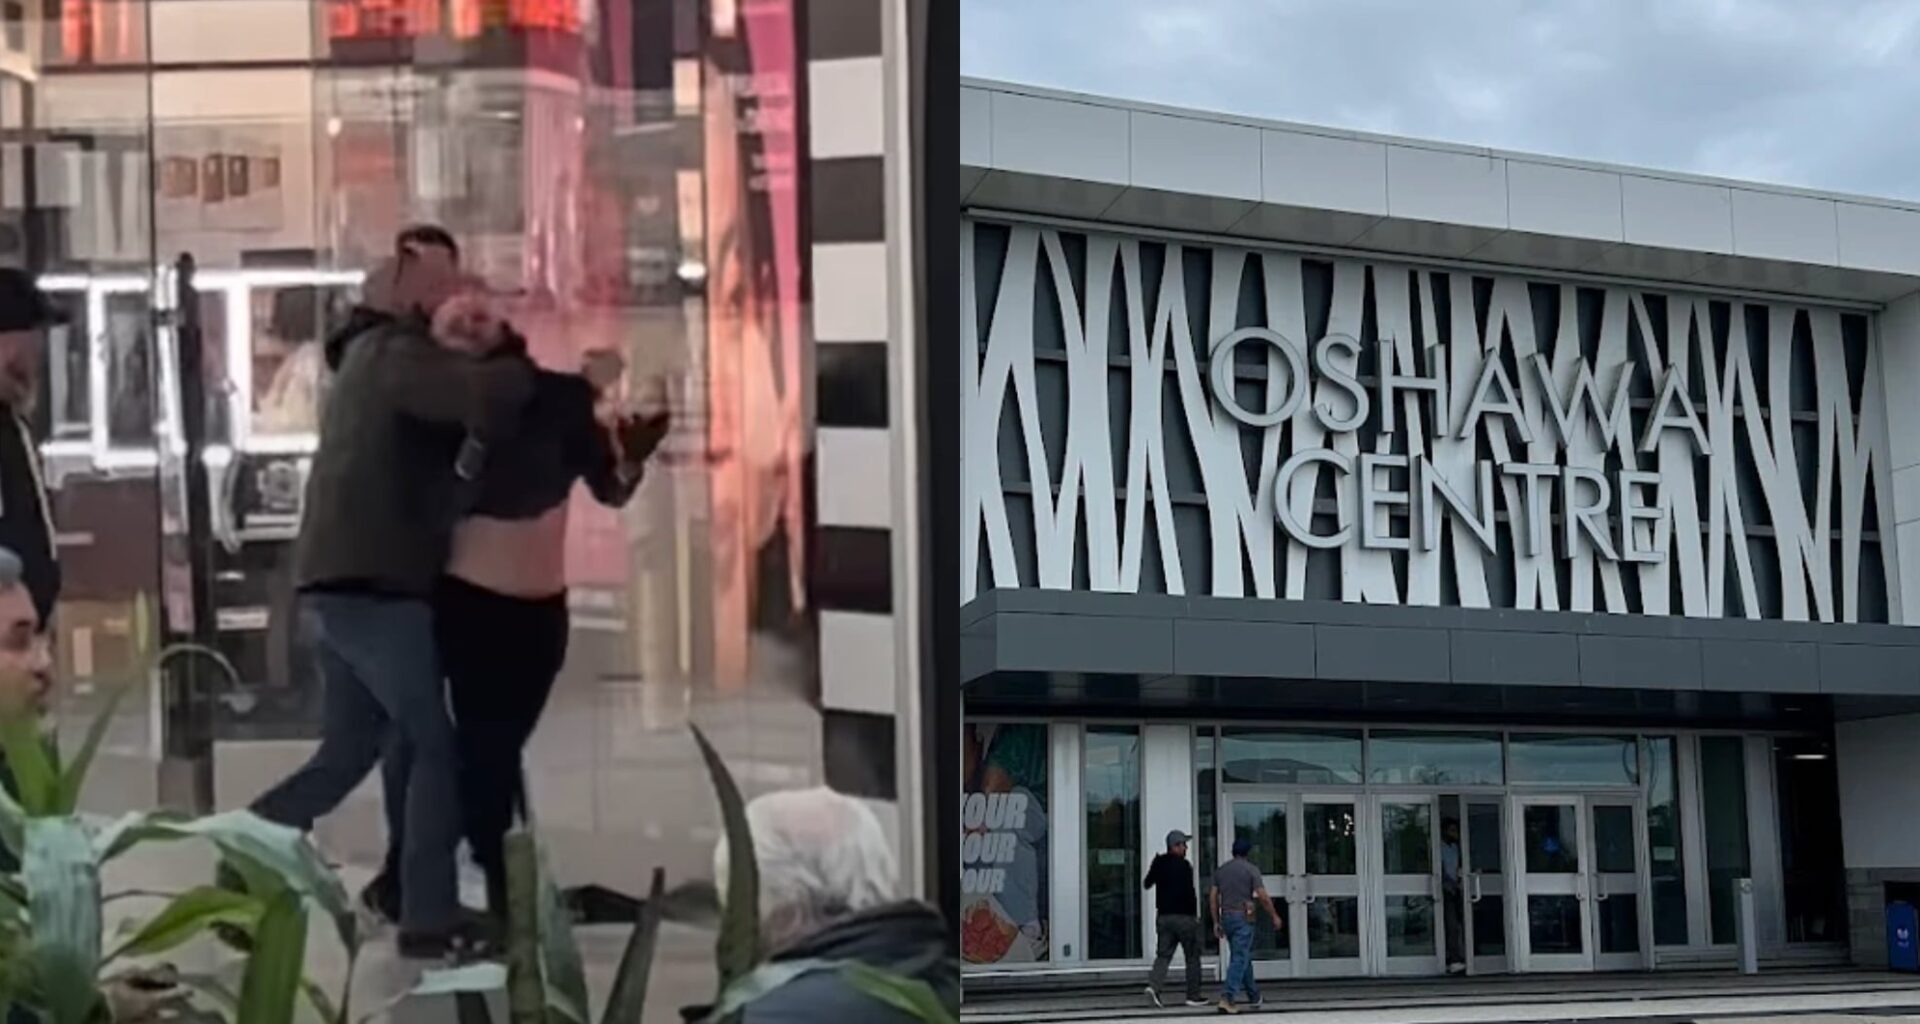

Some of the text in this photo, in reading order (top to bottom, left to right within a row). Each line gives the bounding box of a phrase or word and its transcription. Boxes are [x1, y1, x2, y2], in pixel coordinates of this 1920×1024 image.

[1209, 327, 1711, 455] OSHAWA
[1274, 448, 1665, 562] CENTRE
[964, 792, 1028, 829] OUR
